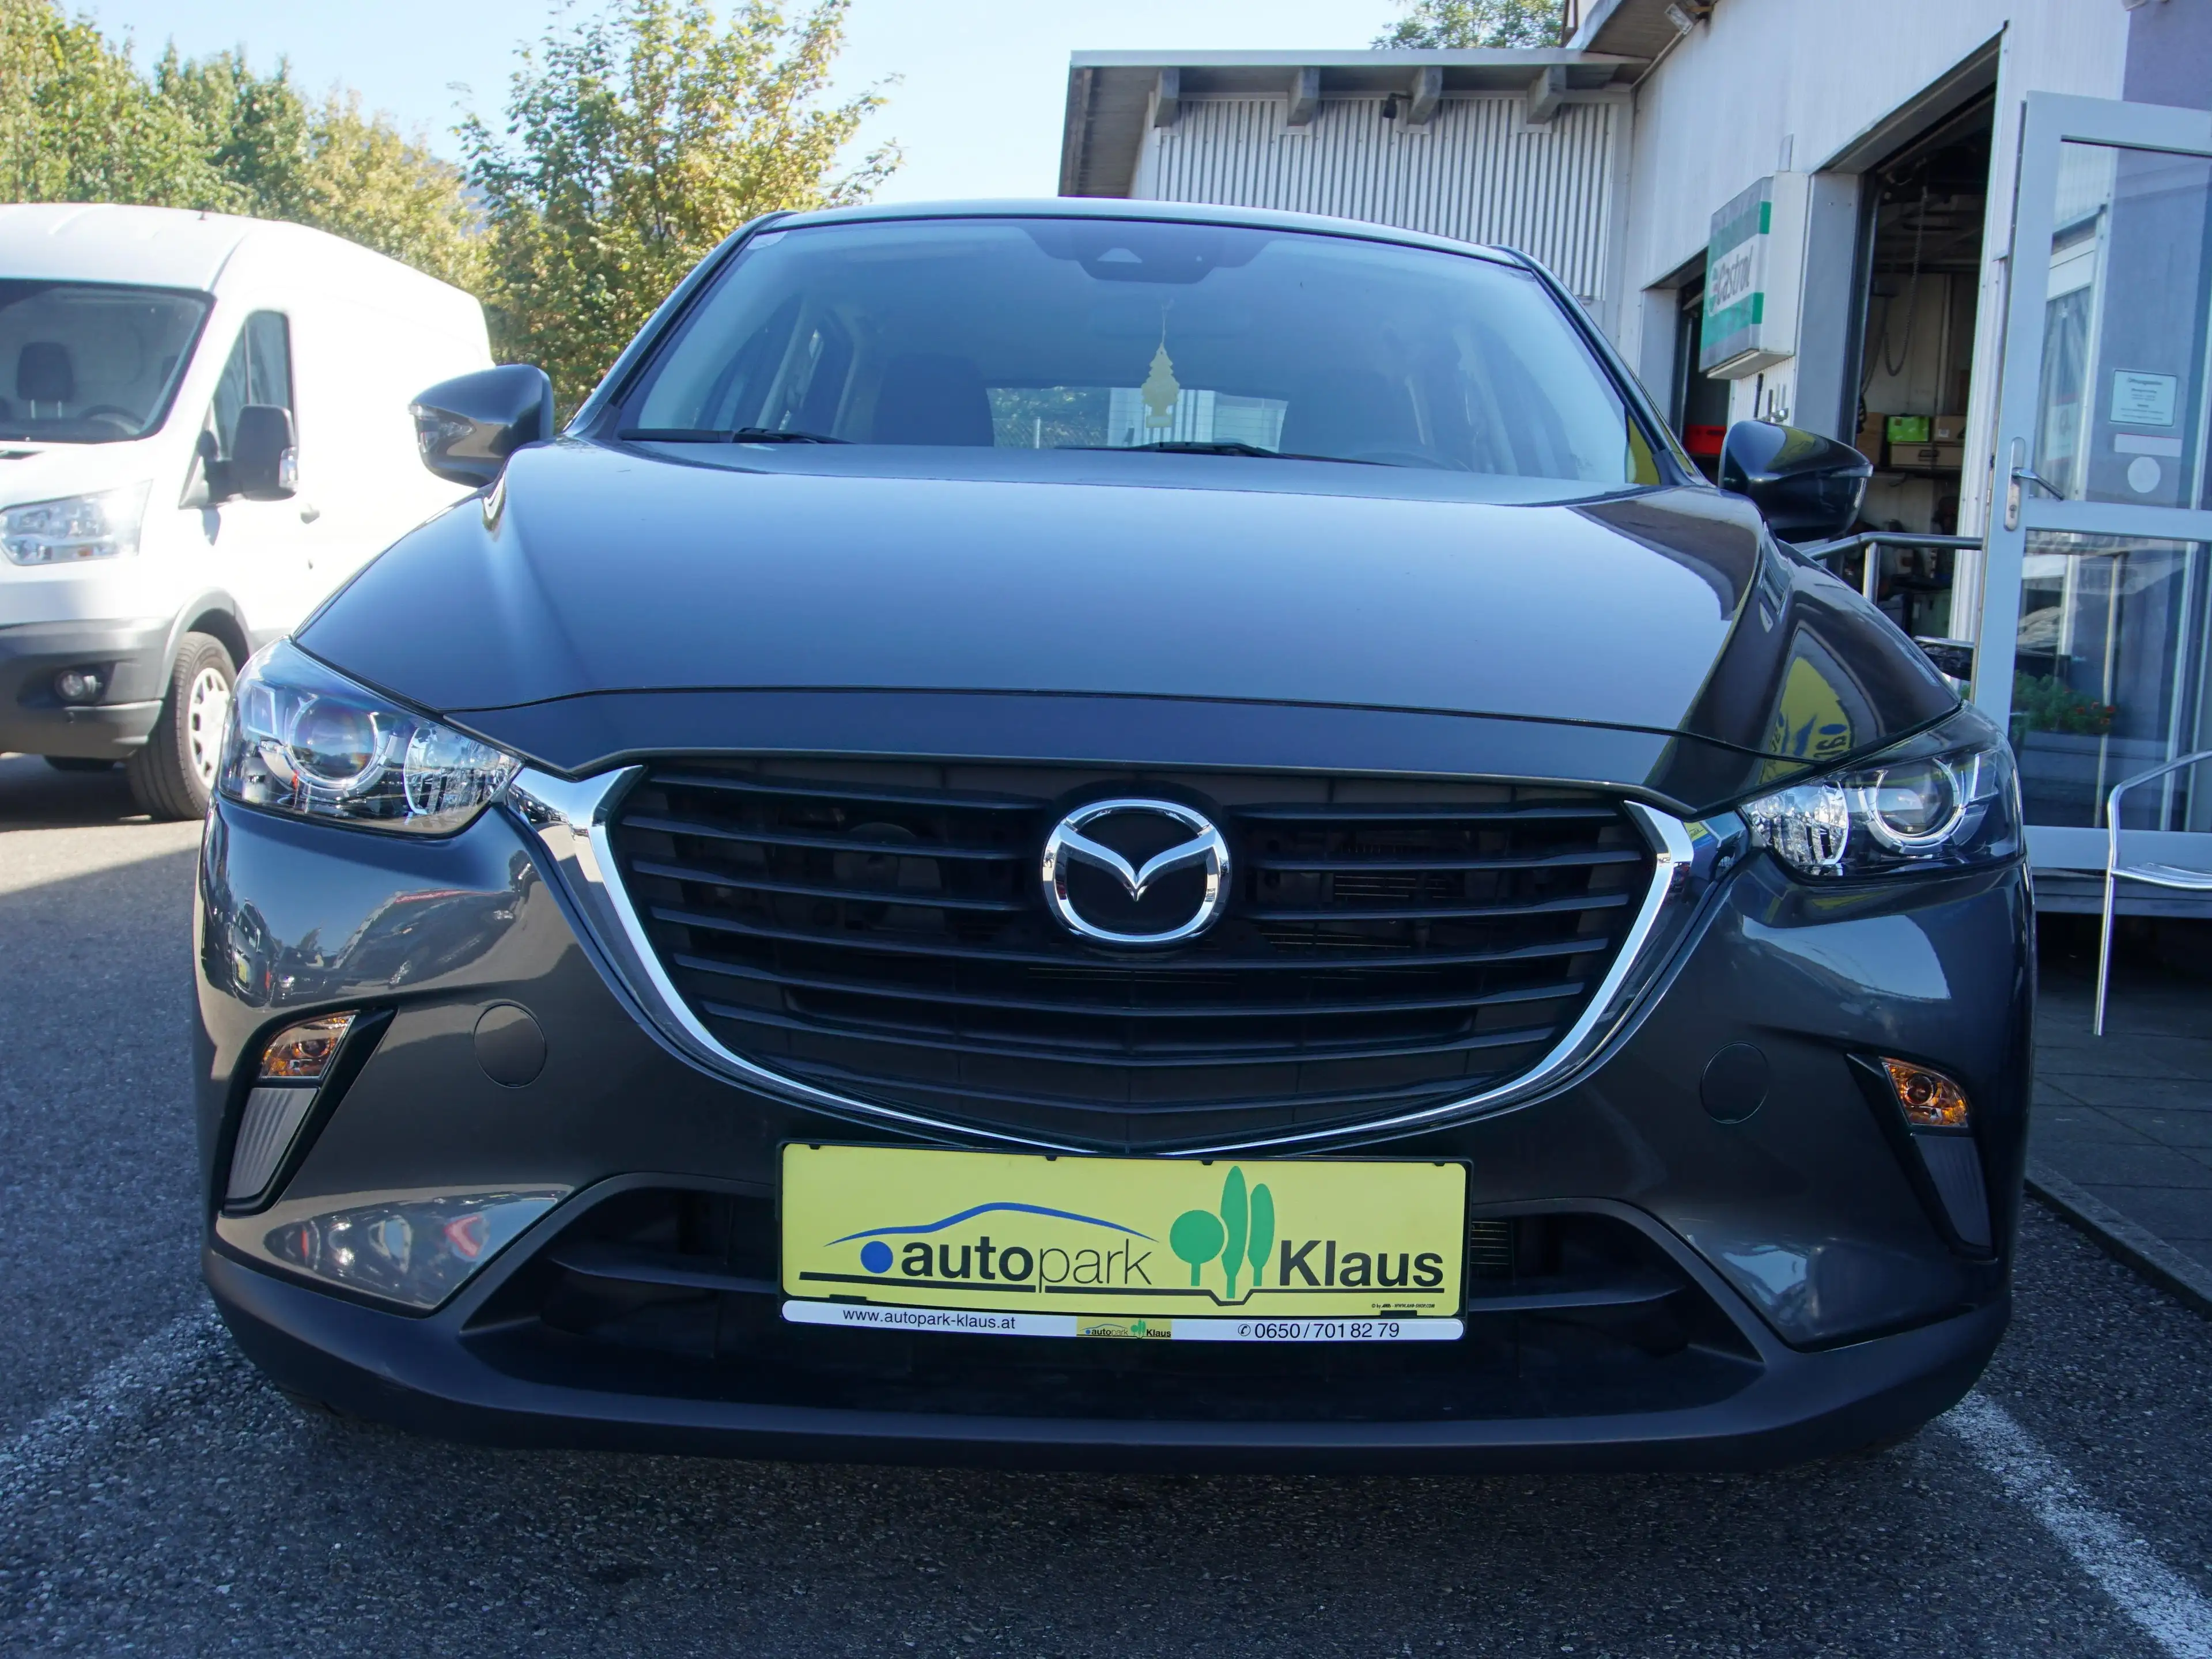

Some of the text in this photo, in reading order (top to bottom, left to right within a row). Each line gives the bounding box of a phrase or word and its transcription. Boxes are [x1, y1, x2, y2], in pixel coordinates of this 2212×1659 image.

[1716, 244, 1753, 305] Castrol
[901, 1236, 1443, 1293] autopark Klaus
[843, 1309, 1016, 1329] www.autopark-klaus.at
[1091, 1328, 1171, 1338] autopark Klaus
